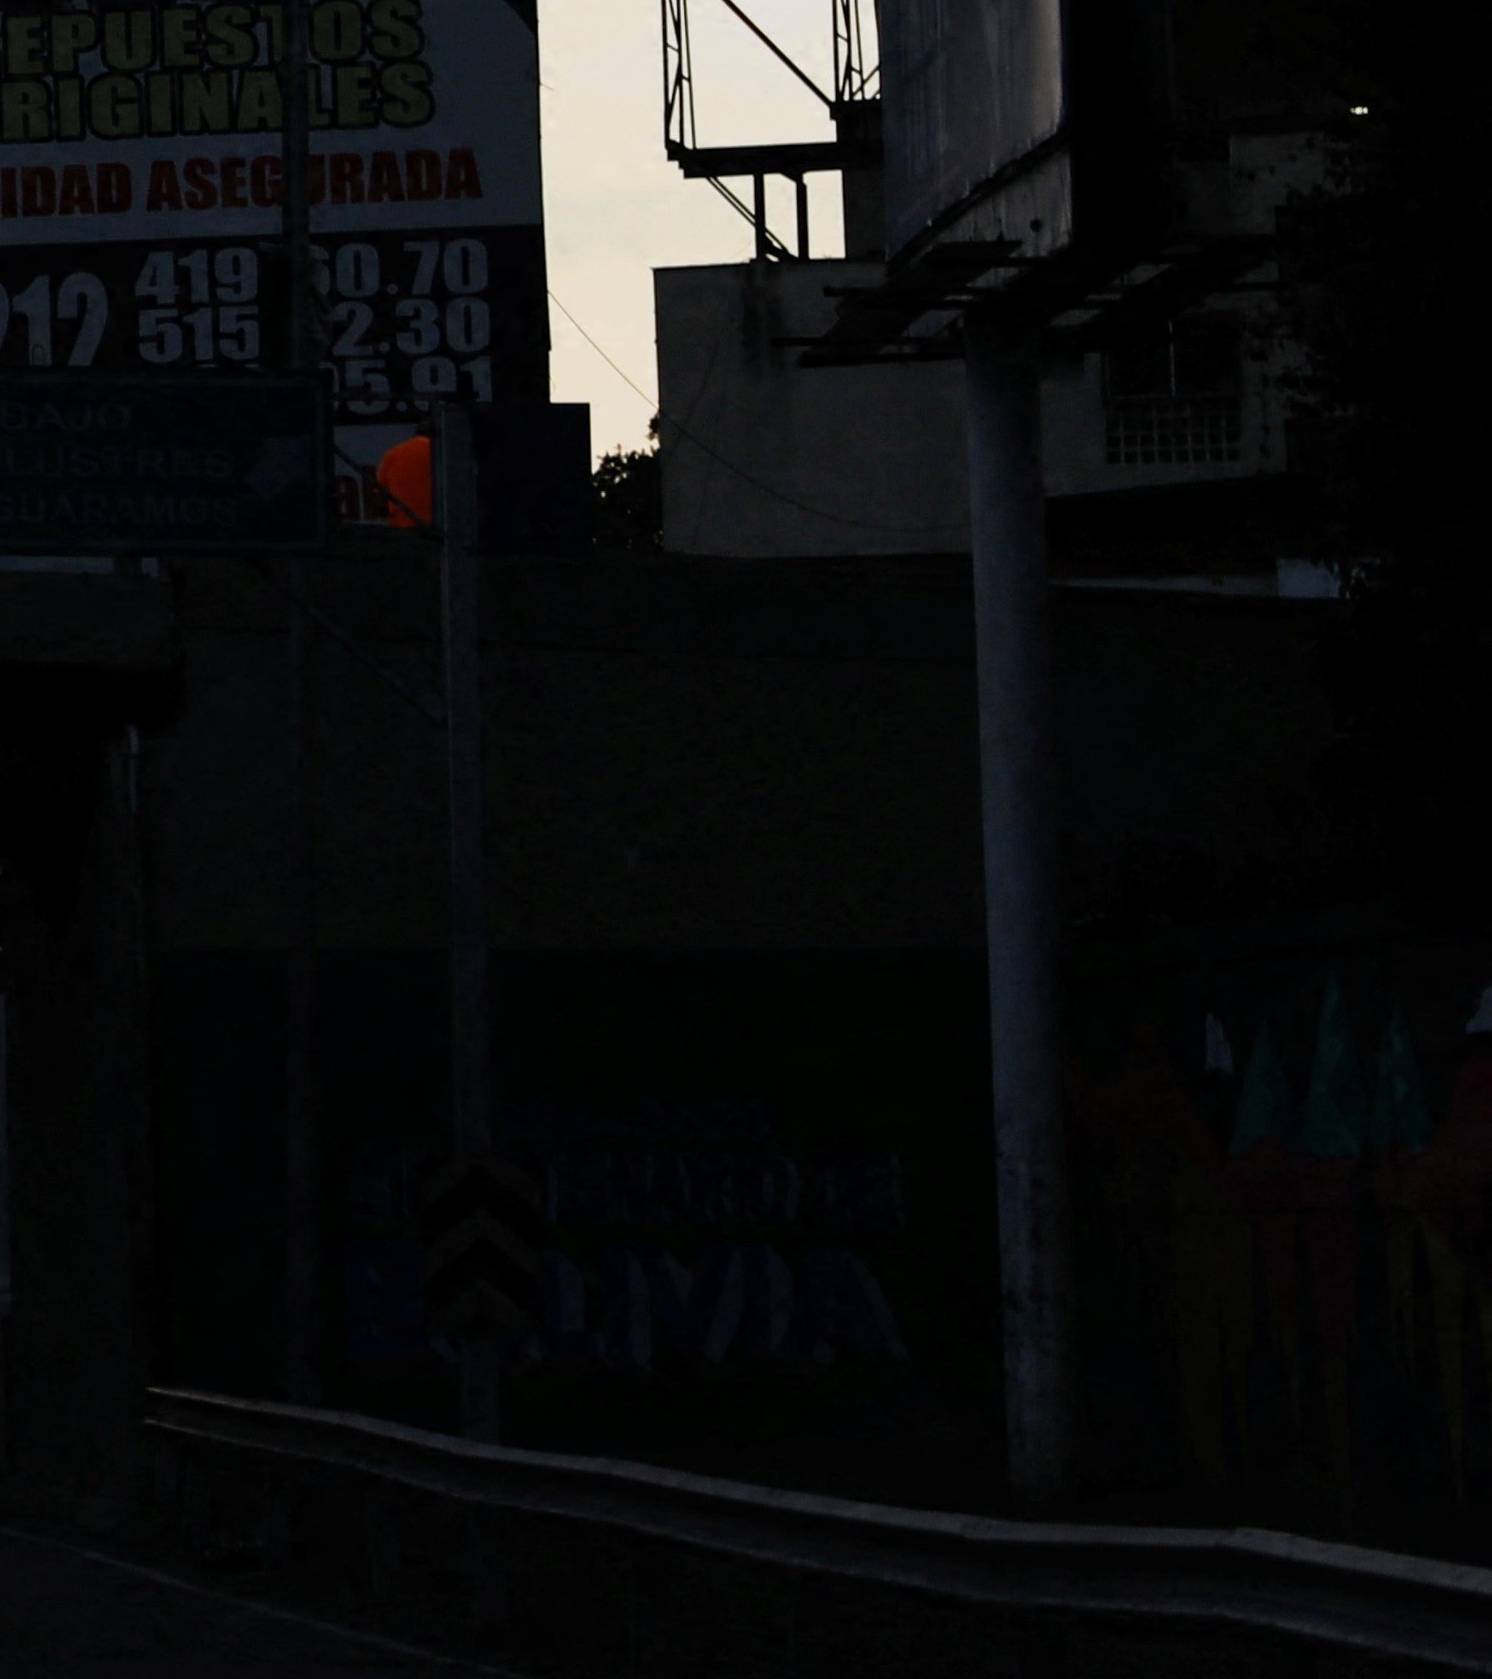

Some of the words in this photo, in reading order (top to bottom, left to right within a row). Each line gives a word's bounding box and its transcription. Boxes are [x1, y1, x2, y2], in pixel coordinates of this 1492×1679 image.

[134, 246, 259, 306] 419
[138, 305, 260, 364] 515
[328, 297, 492, 357] 2.30
[344, 1239, 911, 1373] BLIVIA
